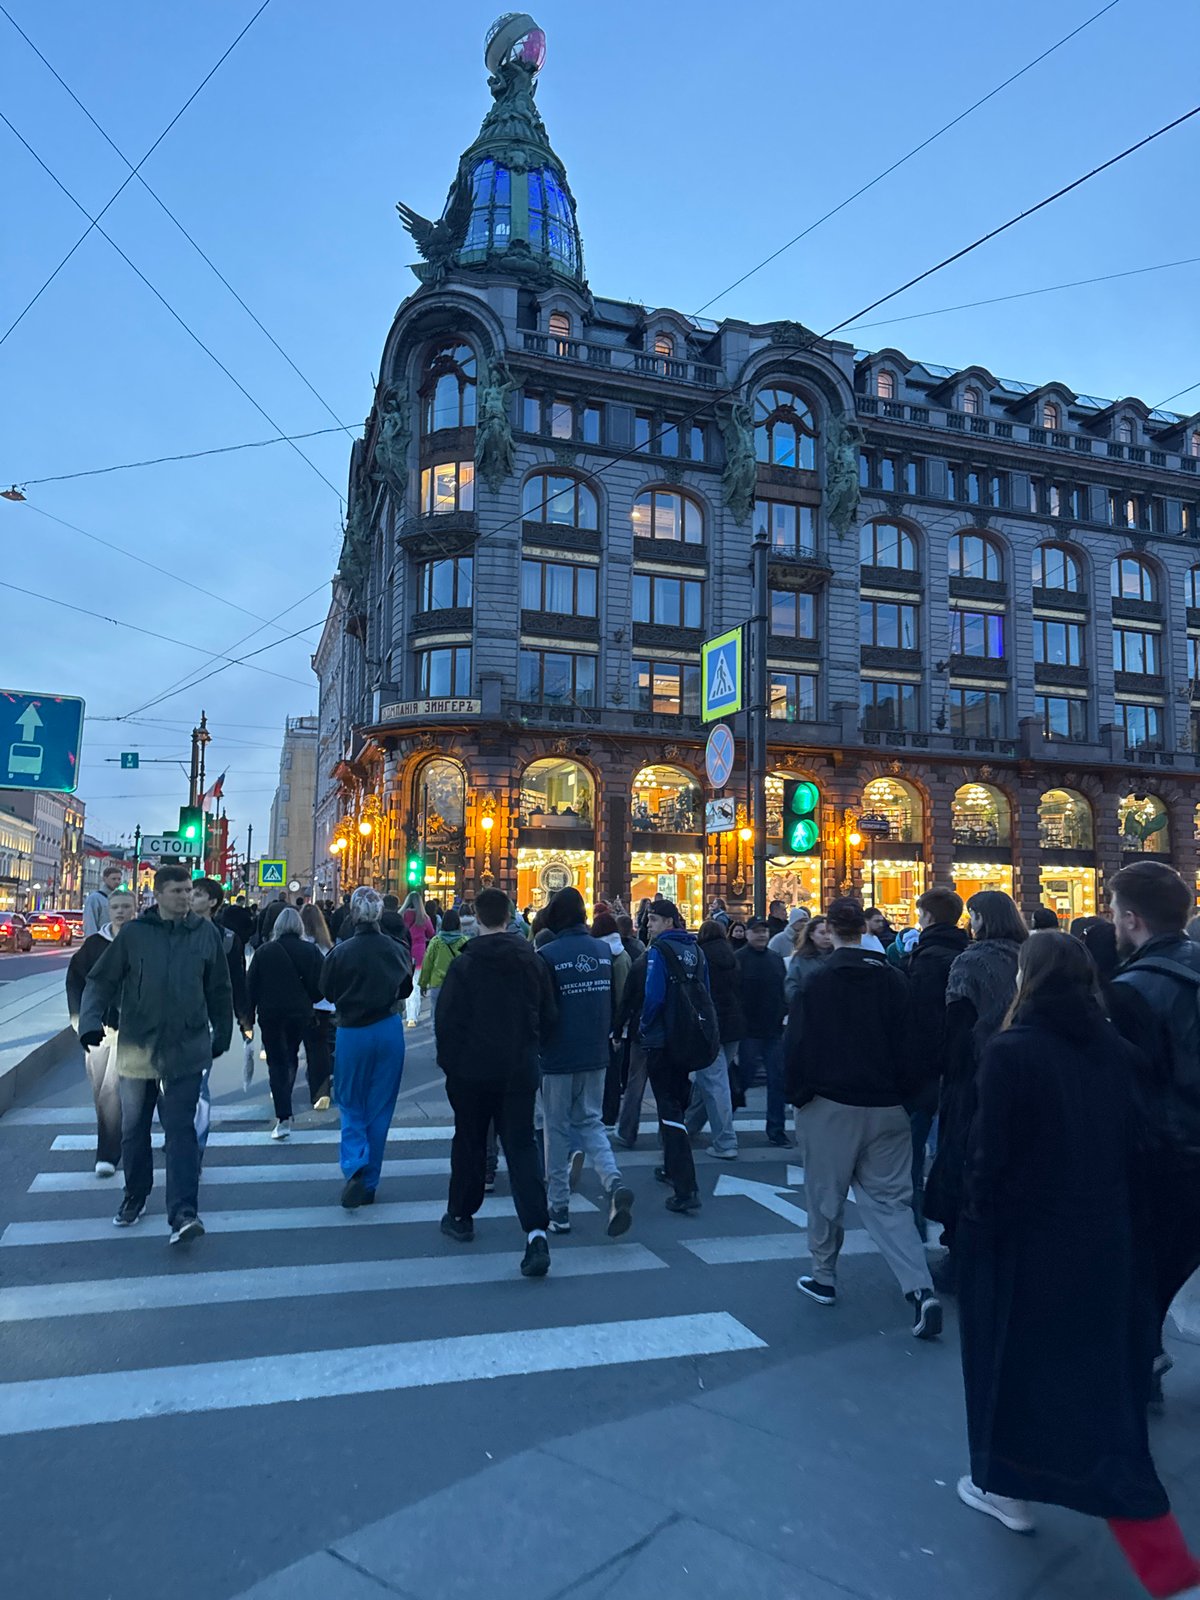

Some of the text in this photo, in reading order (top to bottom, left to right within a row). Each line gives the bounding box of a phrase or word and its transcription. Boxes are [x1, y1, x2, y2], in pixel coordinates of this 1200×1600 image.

[424, 701, 474, 713] ЗИНГЕРЪ
[150, 839, 193, 853] СТОП
[555, 962, 573, 971] КЛУБ
